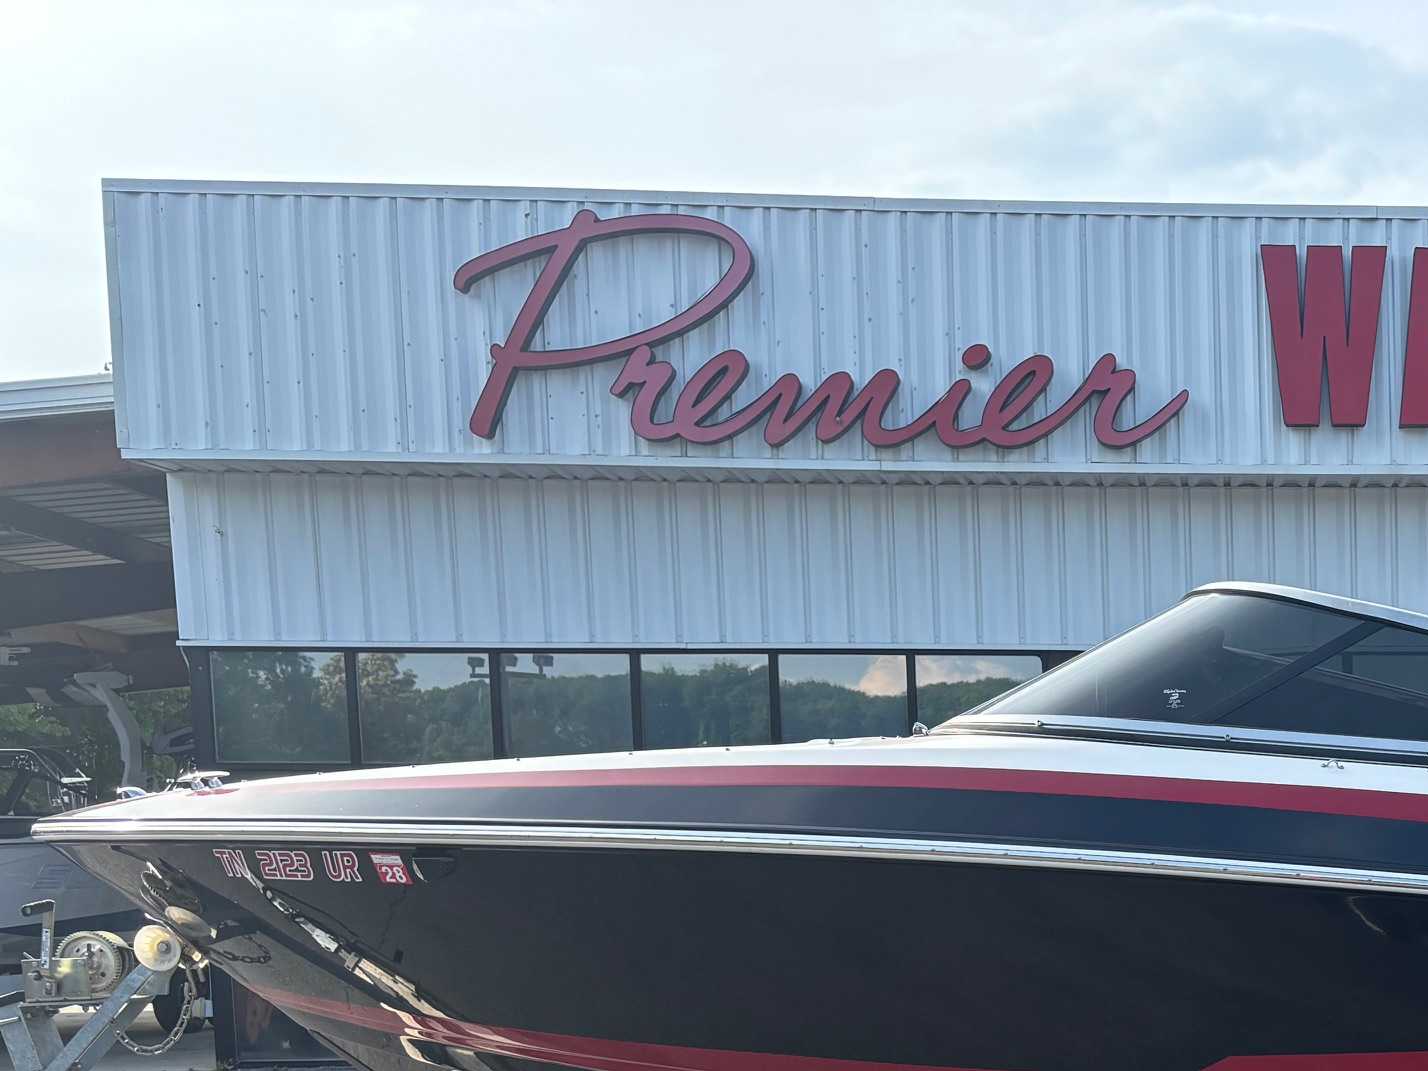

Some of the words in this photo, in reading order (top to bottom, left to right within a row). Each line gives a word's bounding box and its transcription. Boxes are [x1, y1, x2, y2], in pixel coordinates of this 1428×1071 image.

[453, 208, 1190, 449] Premier
[212, 848, 251, 878] TN
[255, 850, 314, 881] 2123
[321, 850, 363, 882] UR
